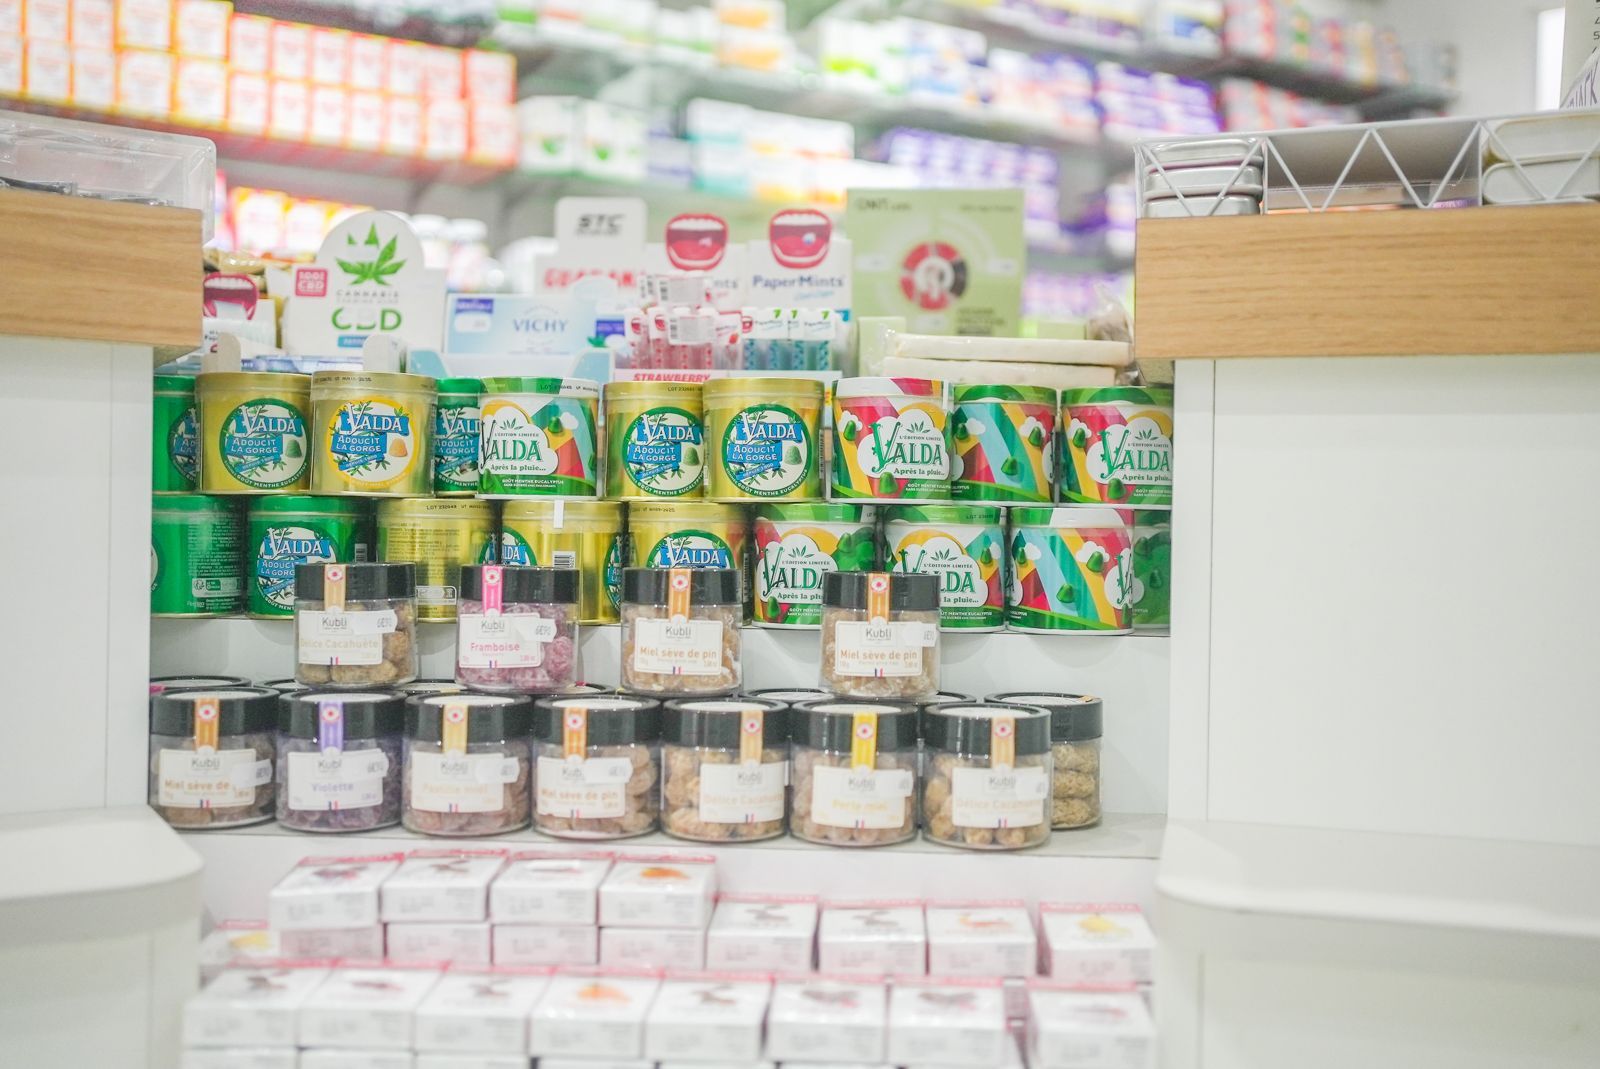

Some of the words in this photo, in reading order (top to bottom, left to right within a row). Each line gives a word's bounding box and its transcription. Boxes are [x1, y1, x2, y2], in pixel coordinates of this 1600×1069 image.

[752, 275, 844, 289] PaperMints
[513, 318, 569, 332] VICHY
[633, 373, 711, 382] STRAWBERRY
[236, 403, 297, 437] VALDA
[342, 402, 402, 435] VALDA
[639, 412, 695, 446] VALDA
[738, 411, 796, 445] VALDA
[232, 437, 277, 446] ADOUCIT
[337, 435, 380, 445] ADOUCIT
[480, 419, 543, 469] VALDA
[634, 446, 675, 454] ADOUCIT
[733, 445, 776, 453] ADOUCIT
[868, 421, 943, 474] VALDA
[1097, 429, 1170, 480] VALDA
[490, 464, 509, 472] Après
[893, 467, 917, 475] Après
[265, 527, 322, 560] VALDA
[663, 536, 720, 568] VALDA
[777, 592, 797, 600] Après
[321, 617, 347, 627] Kubli
[481, 619, 505, 630] Kubli
[665, 625, 692, 636] Kubli
[865, 628, 892, 639] Kubli
[325, 638, 379, 649] Cacahuète
[470, 642, 520, 652] Framboise
[640, 646, 658, 657] Miel
[661, 648, 685, 658] sève
[687, 649, 699, 658] de
[702, 650, 717, 660] pin
[840, 649, 859, 660] Miel
[862, 650, 886, 660] sève
[888, 650, 901, 660] de
[903, 651, 918, 662] pin
[191, 757, 220, 768] Kubli
[318, 759, 342, 769] Kubl
[440, 761, 468, 773] Kubli
[737, 770, 763, 782] Kubli
[988, 775, 1017, 787] Kubli
[164, 779, 184, 790] Miel
[187, 780, 213, 790] sève
[216, 779, 230, 790] de
[311, 782, 354, 792] Violette
[848, 777, 876, 789] Kubli
[585, 790, 598, 800] de
